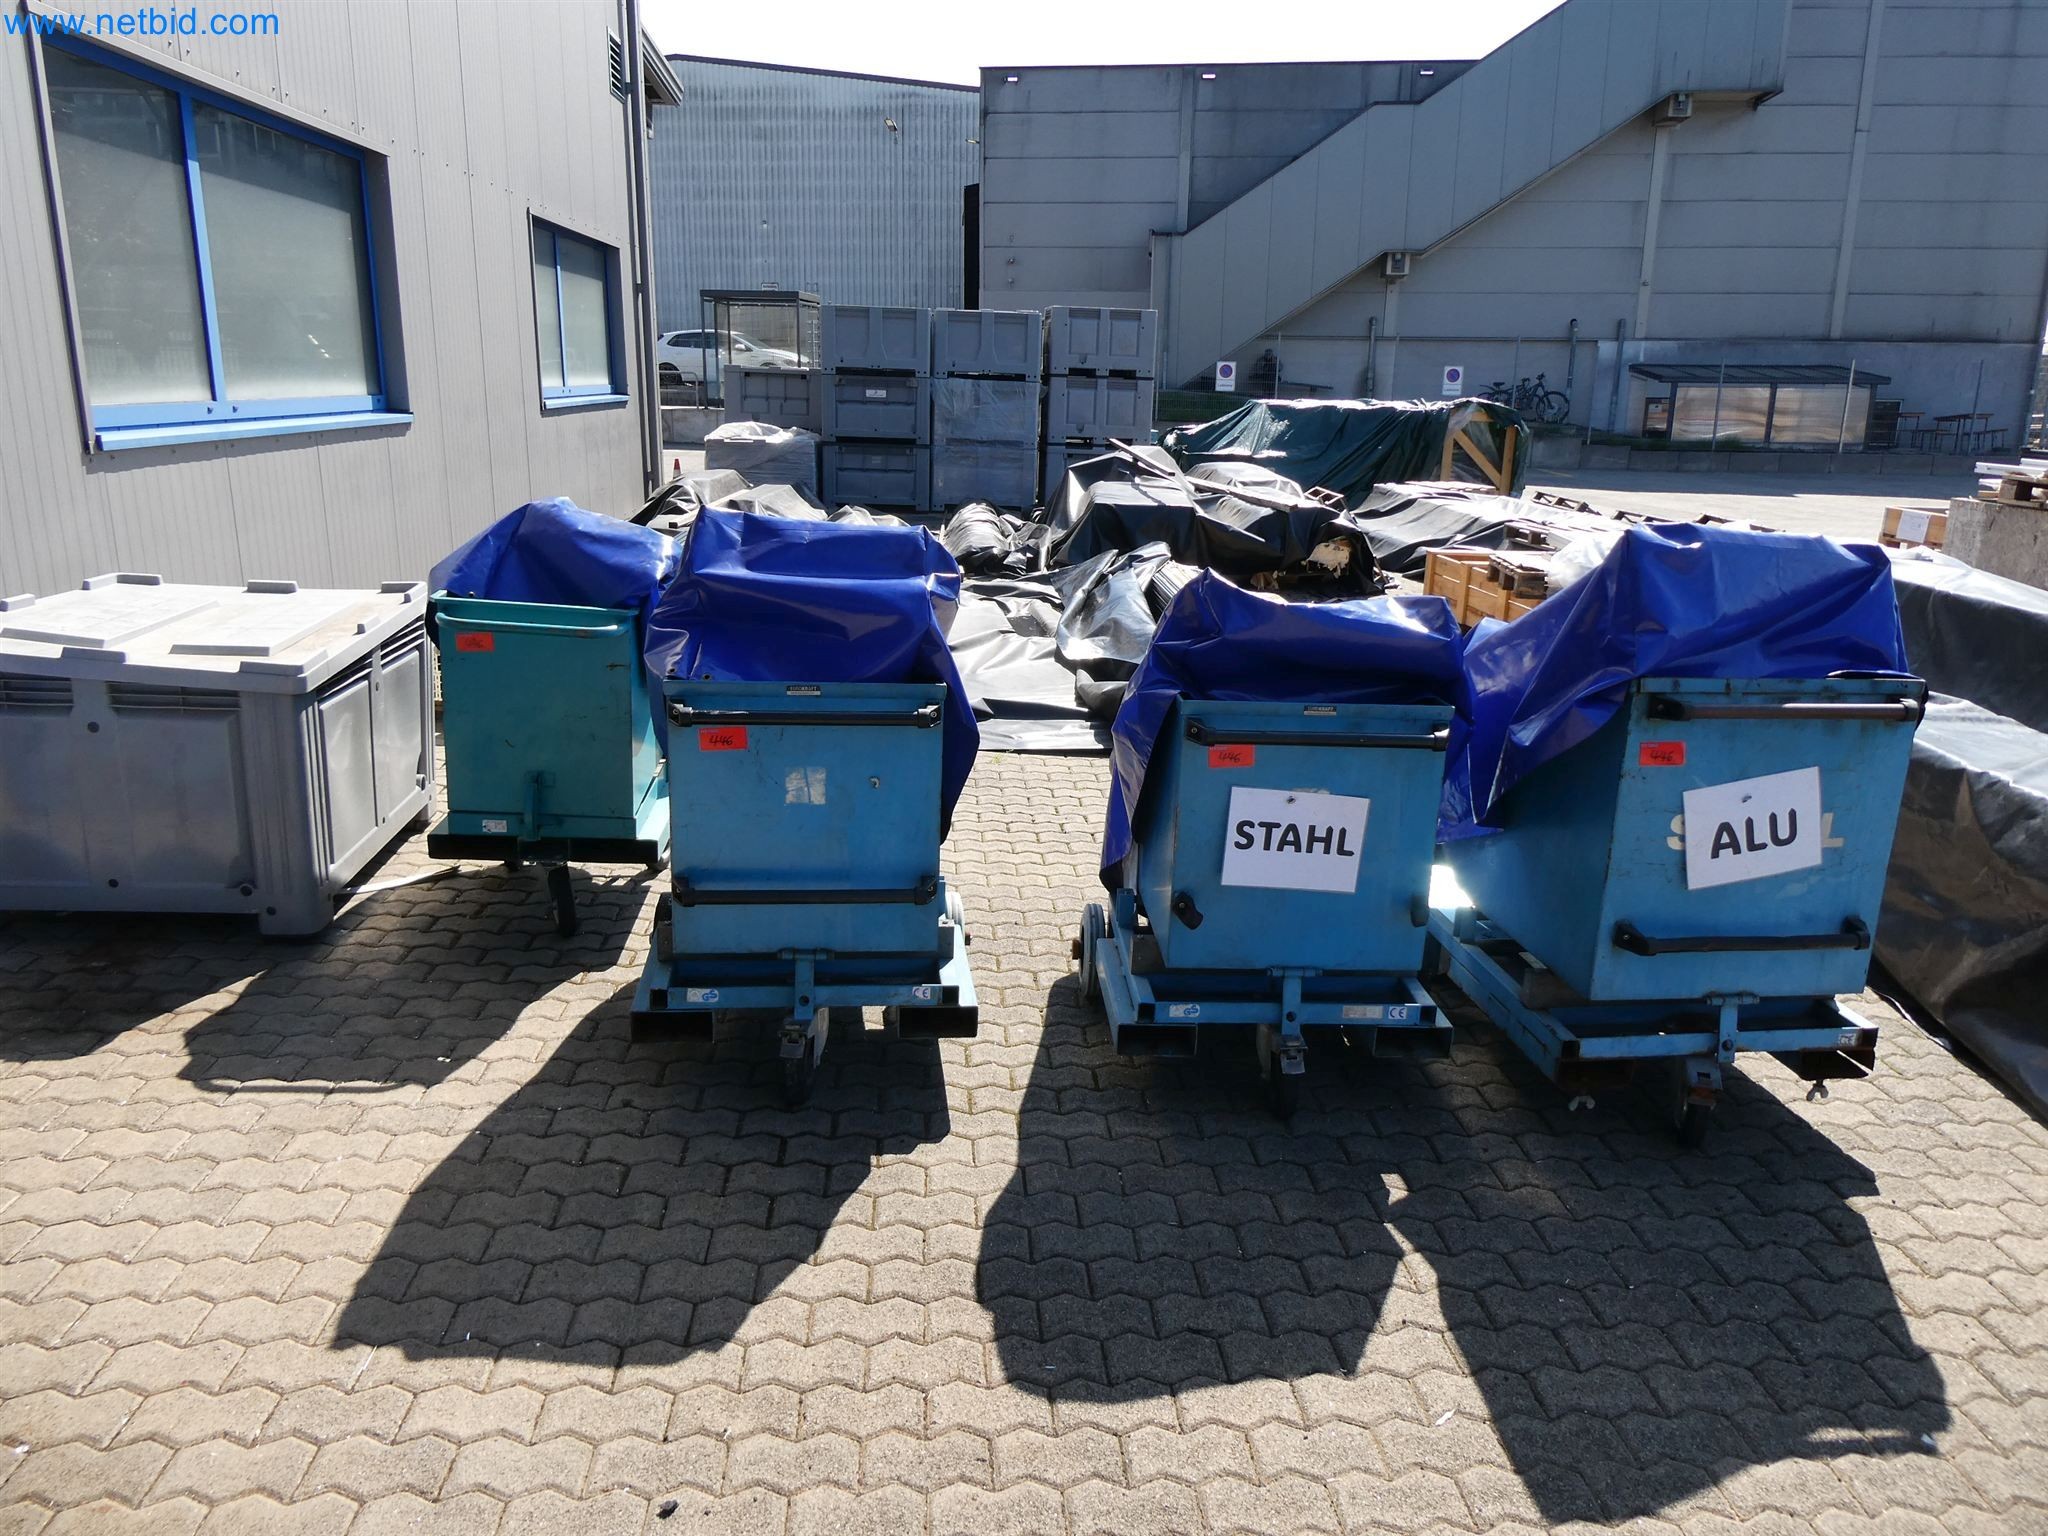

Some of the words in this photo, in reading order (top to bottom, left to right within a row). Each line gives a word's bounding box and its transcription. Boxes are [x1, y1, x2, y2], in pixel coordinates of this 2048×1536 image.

[708, 735, 734, 746] 446
[1234, 820, 1355, 857] STAHL
[1711, 808, 1798, 860] ALU
[1389, 1007, 1406, 1018] CE
